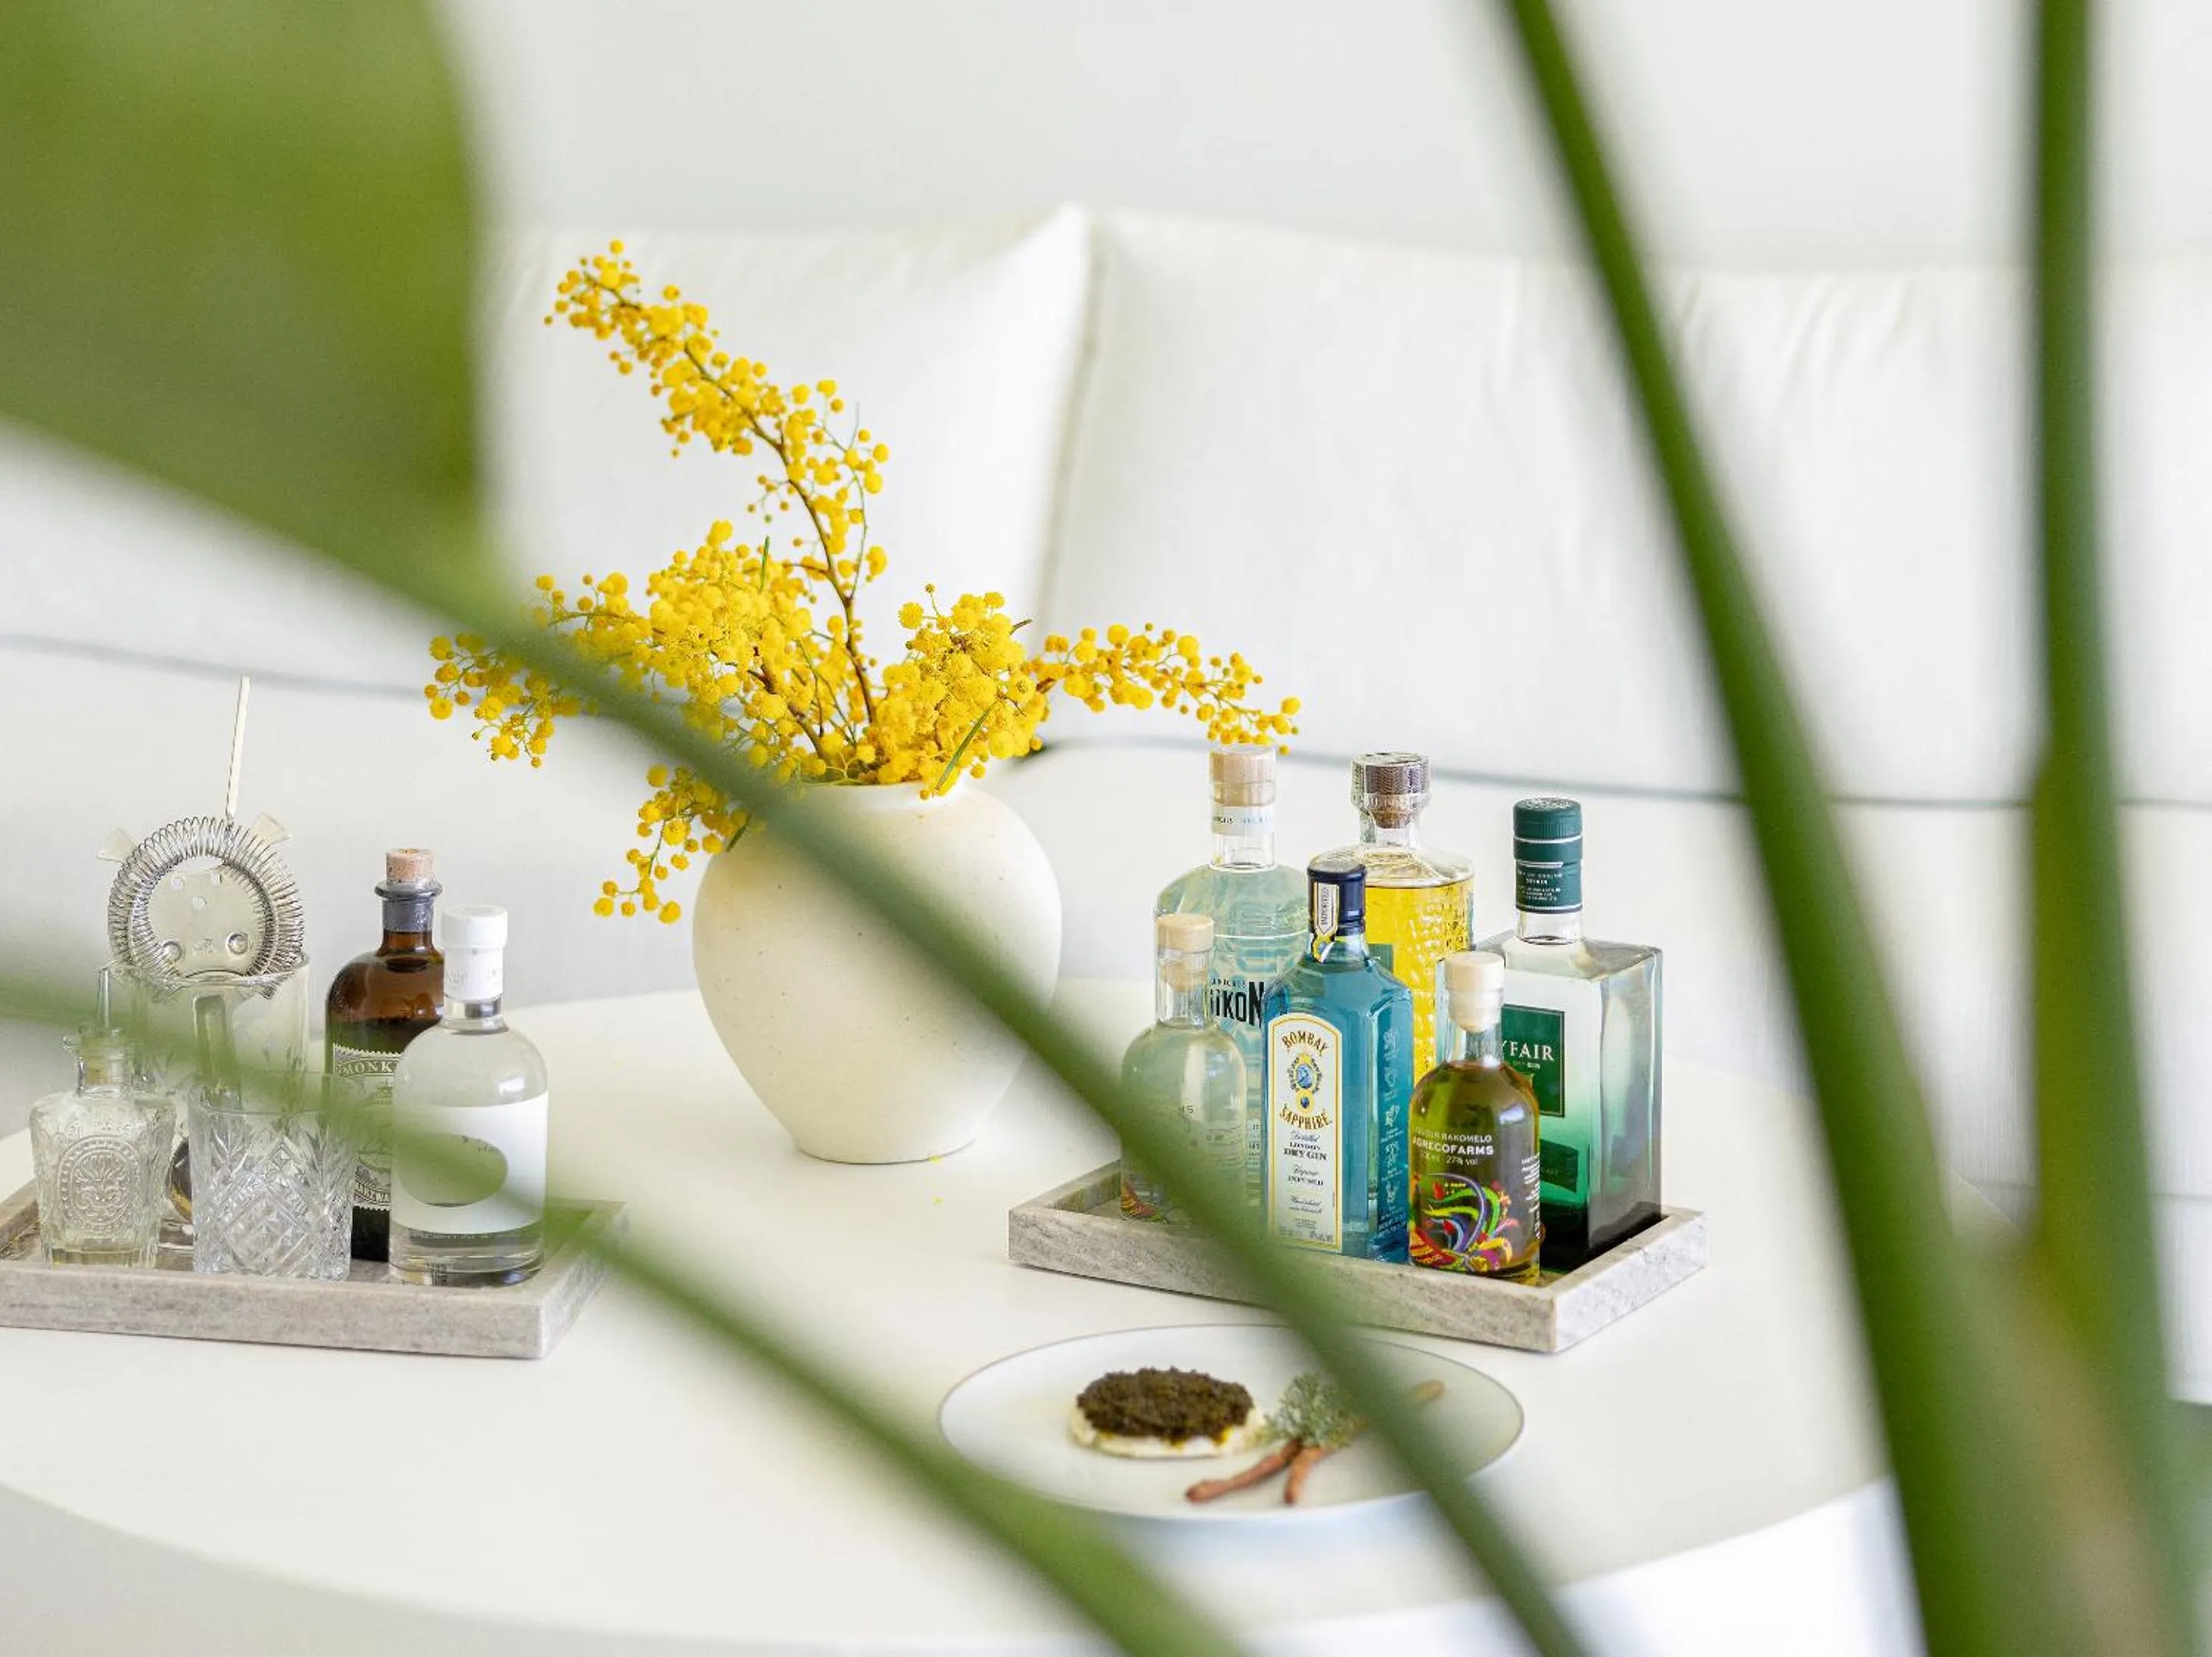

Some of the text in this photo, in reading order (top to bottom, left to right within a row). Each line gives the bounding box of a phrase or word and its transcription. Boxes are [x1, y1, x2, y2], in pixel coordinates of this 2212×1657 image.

[1281, 1030, 1329, 1057] BOMBAY
[343, 1061, 394, 1075] MONK
[1280, 1103, 1333, 1130] SAPPHIRE
[1442, 1131, 1492, 1143] RAKOMELO
[1306, 1150, 1328, 1162] GIN
